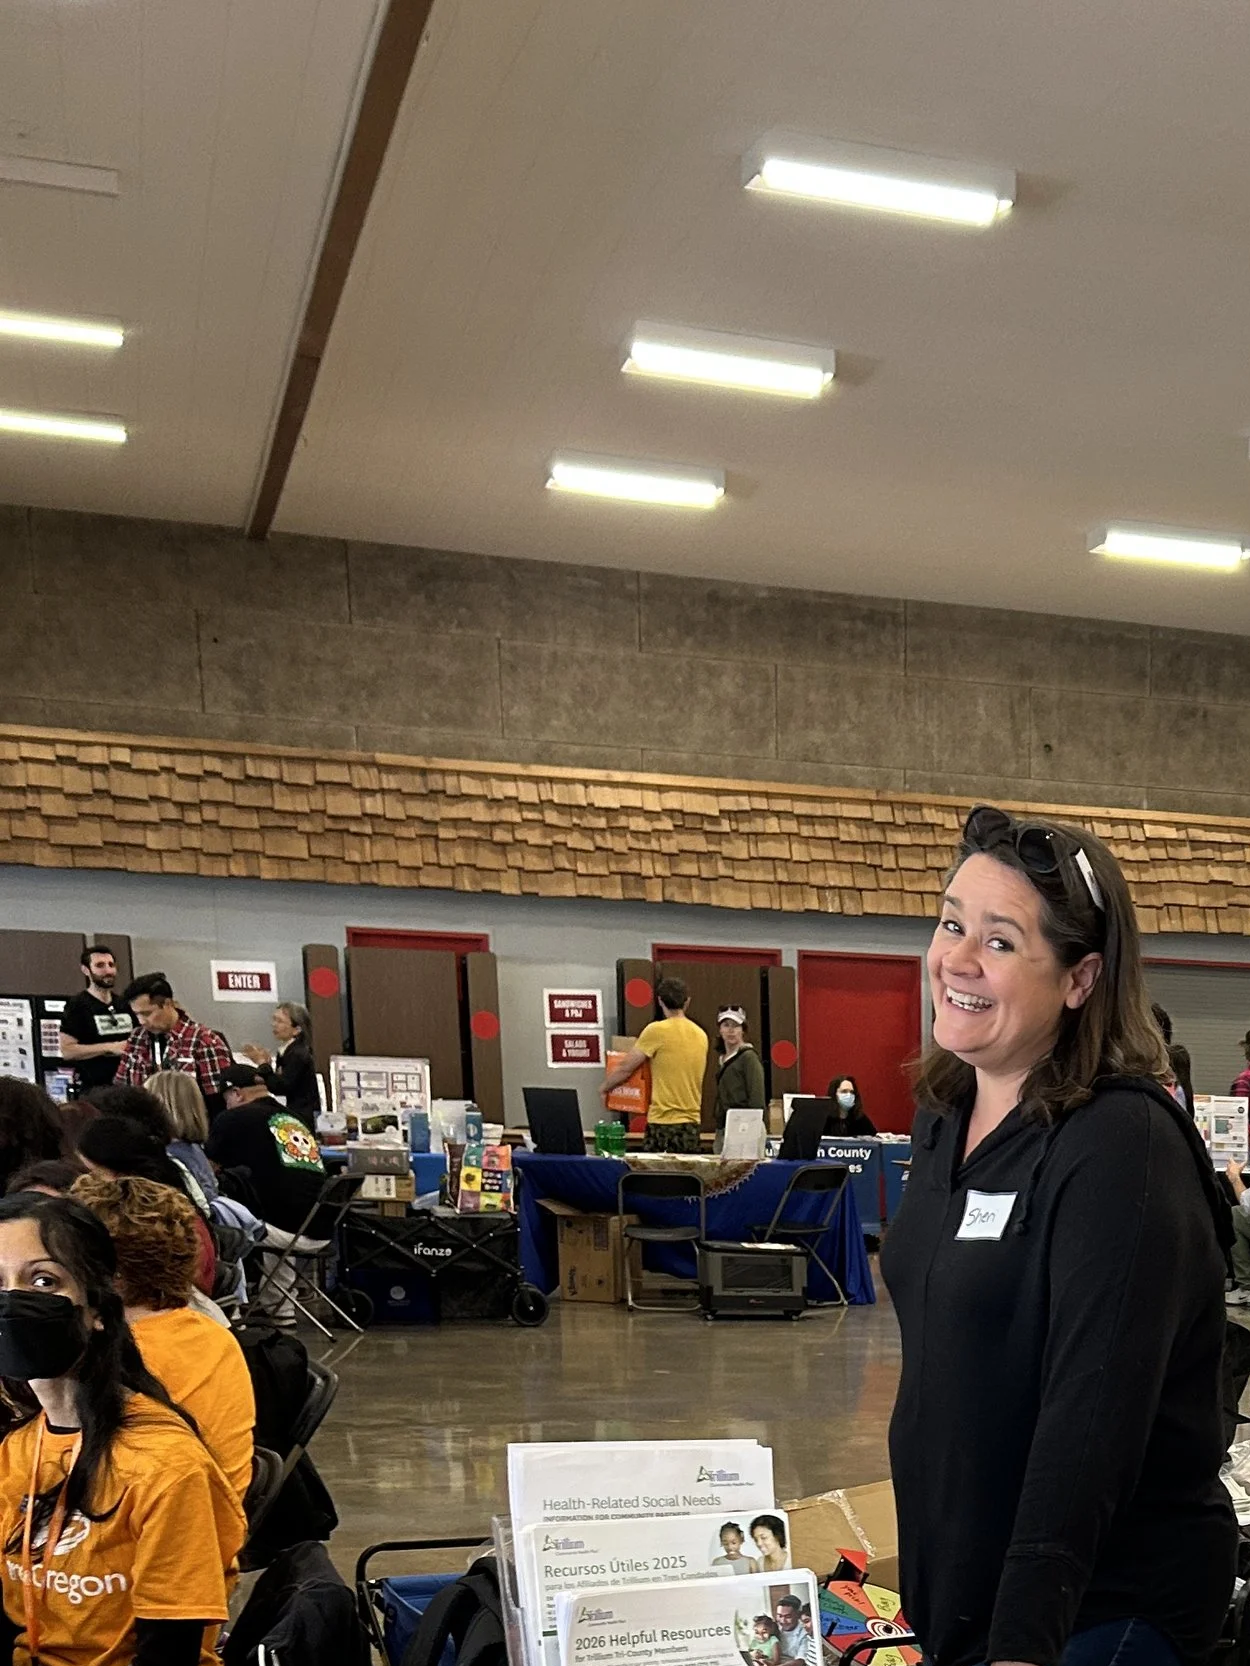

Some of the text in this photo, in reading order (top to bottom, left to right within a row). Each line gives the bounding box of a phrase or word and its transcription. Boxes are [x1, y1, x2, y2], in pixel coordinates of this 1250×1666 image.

[228, 973, 261, 990] ENTER
[553, 999, 593, 1009] SANDWICHES
[828, 1147, 872, 1160] County
[543, 1494, 721, 1511] Health-Related Social Needs
[544, 1556, 687, 1578] Recursos Útiles 2025
[545, 1582, 562, 1591] para
[575, 1624, 732, 1651] 2026 Helpful Resources
[575, 1646, 688, 1663] for Trillium Tri-County Members
